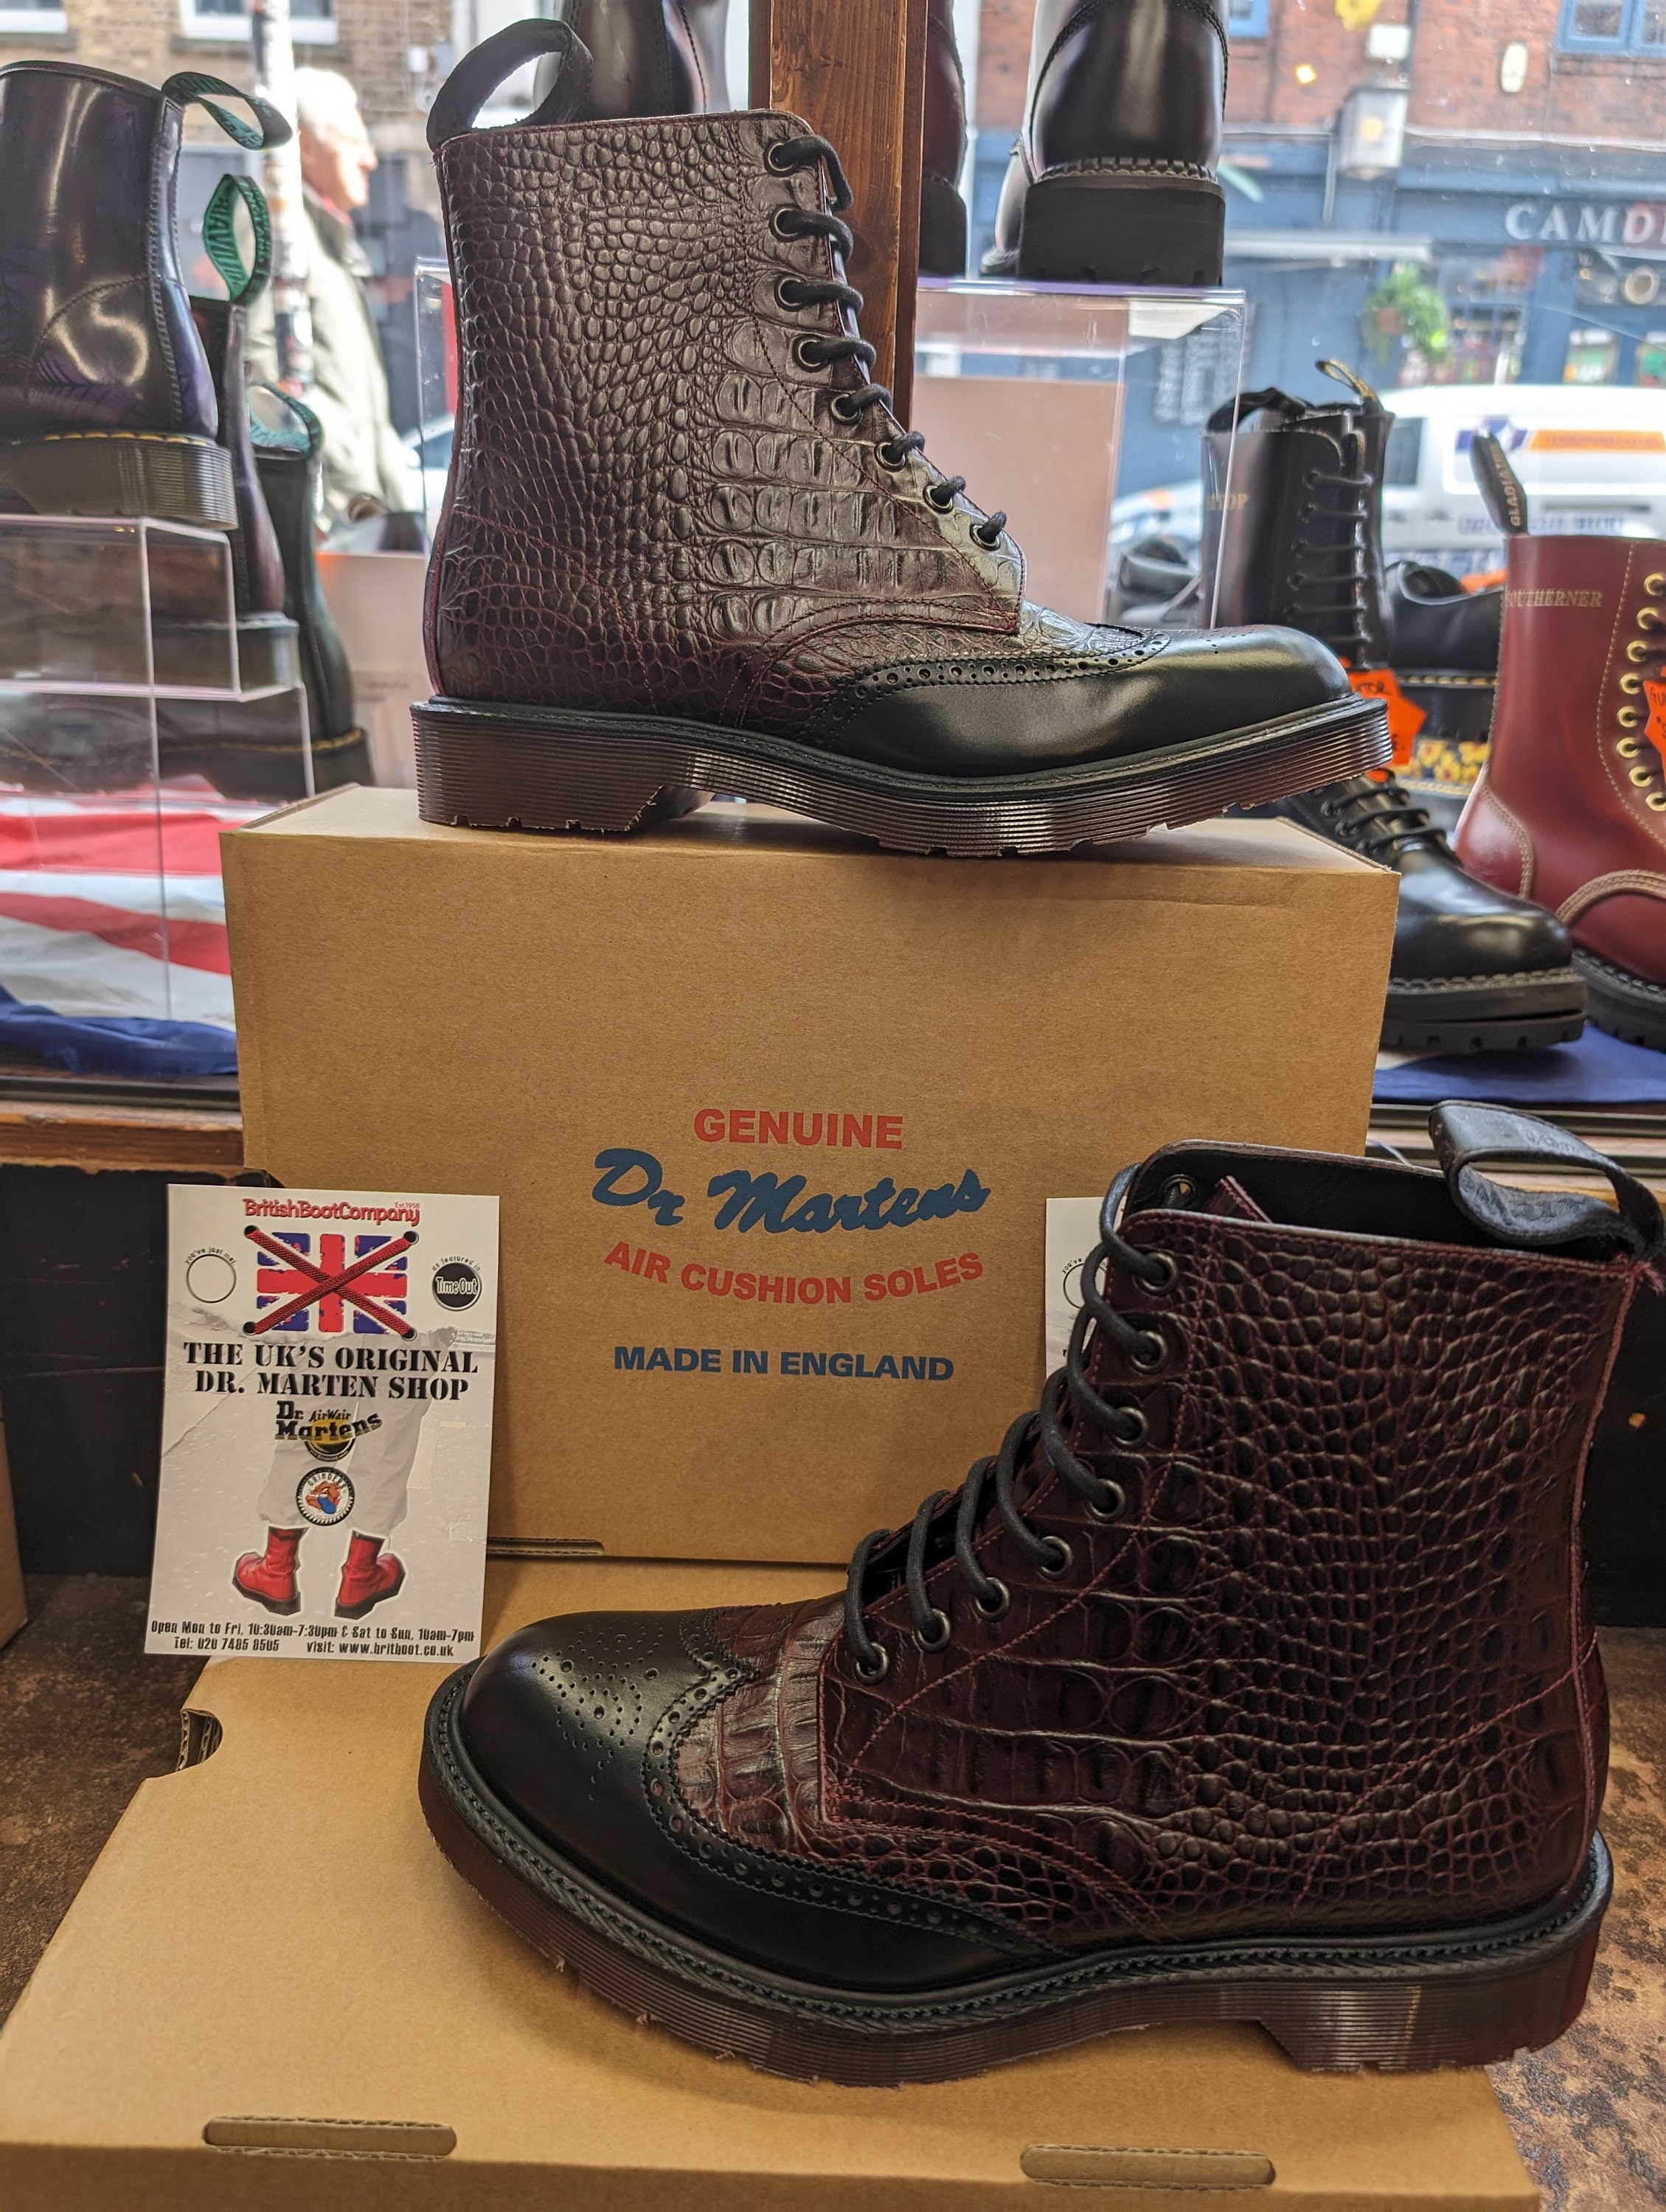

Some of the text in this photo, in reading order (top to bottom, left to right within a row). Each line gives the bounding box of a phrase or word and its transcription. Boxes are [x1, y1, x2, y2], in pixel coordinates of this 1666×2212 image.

[1504, 201, 1666, 244] CAMD
[694, 1108, 903, 1150] GENUINE
[591, 1148, 991, 1234] Dr Martens
[440, 1255, 474, 1266] featured
[603, 1241, 983, 1304] AIR CUSHION SOLES
[184, 1341, 479, 1374] THE UK'S ORIGINAL
[614, 1346, 955, 1381] MADE IN ENGLAND
[195, 1370, 469, 1401] DR. MARTEN SHOP
[274, 1412, 383, 1441] Martens
[308, 1408, 352, 1422] AirWair
[307, 1472, 347, 1490] GRINDERS
[151, 1620, 178, 1635] Open
[181, 1621, 205, 1634] Mon
[209, 1621, 221, 1634] to
[352, 1626, 371, 1638] Sat
[375, 1627, 387, 1638] to
[198, 1637, 218, 1650] 020
[339, 1642, 454, 1657] www.britboot.co.uk
